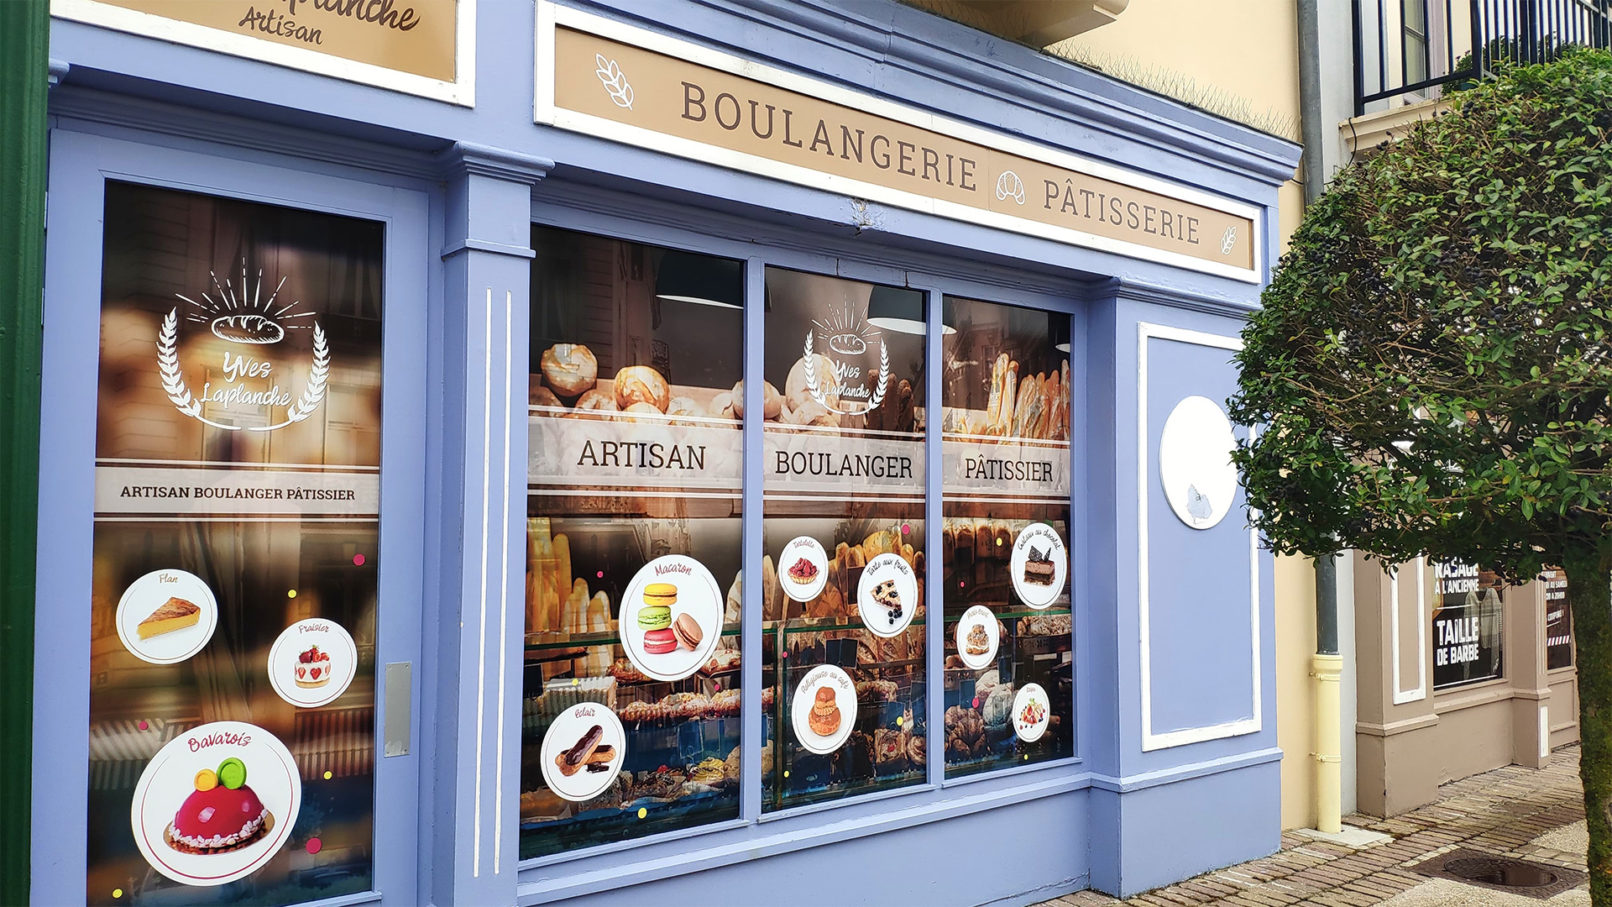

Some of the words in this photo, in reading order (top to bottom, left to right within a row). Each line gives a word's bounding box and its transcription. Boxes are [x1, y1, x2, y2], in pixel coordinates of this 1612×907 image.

[238, 6, 323, 45] Artisan
[681, 81, 977, 192] BOULANGERIE
[1043, 178, 1200, 246] PÂTISSERIE
[222, 351, 272, 382] Yves
[835, 359, 860, 382] Yves
[200, 383, 293, 409] Laplanche
[824, 381, 871, 400] Laplanche
[577, 440, 707, 471] ARTISAN
[775, 451, 913, 480] BOULANGER
[965, 453, 1054, 483] PÂTISSIER
[120, 486, 190, 499] ARTISAN
[194, 487, 283, 500] BOULANGER
[287, 487, 356, 501] PÂTISSIER
[159, 572, 178, 584] Flan
[654, 563, 693, 576] Macaron
[1436, 616, 1479, 646] TAILLE
[1437, 647, 1449, 667] DE
[1450, 643, 1479, 664] BARBE
[187, 731, 252, 753] Bavarois
